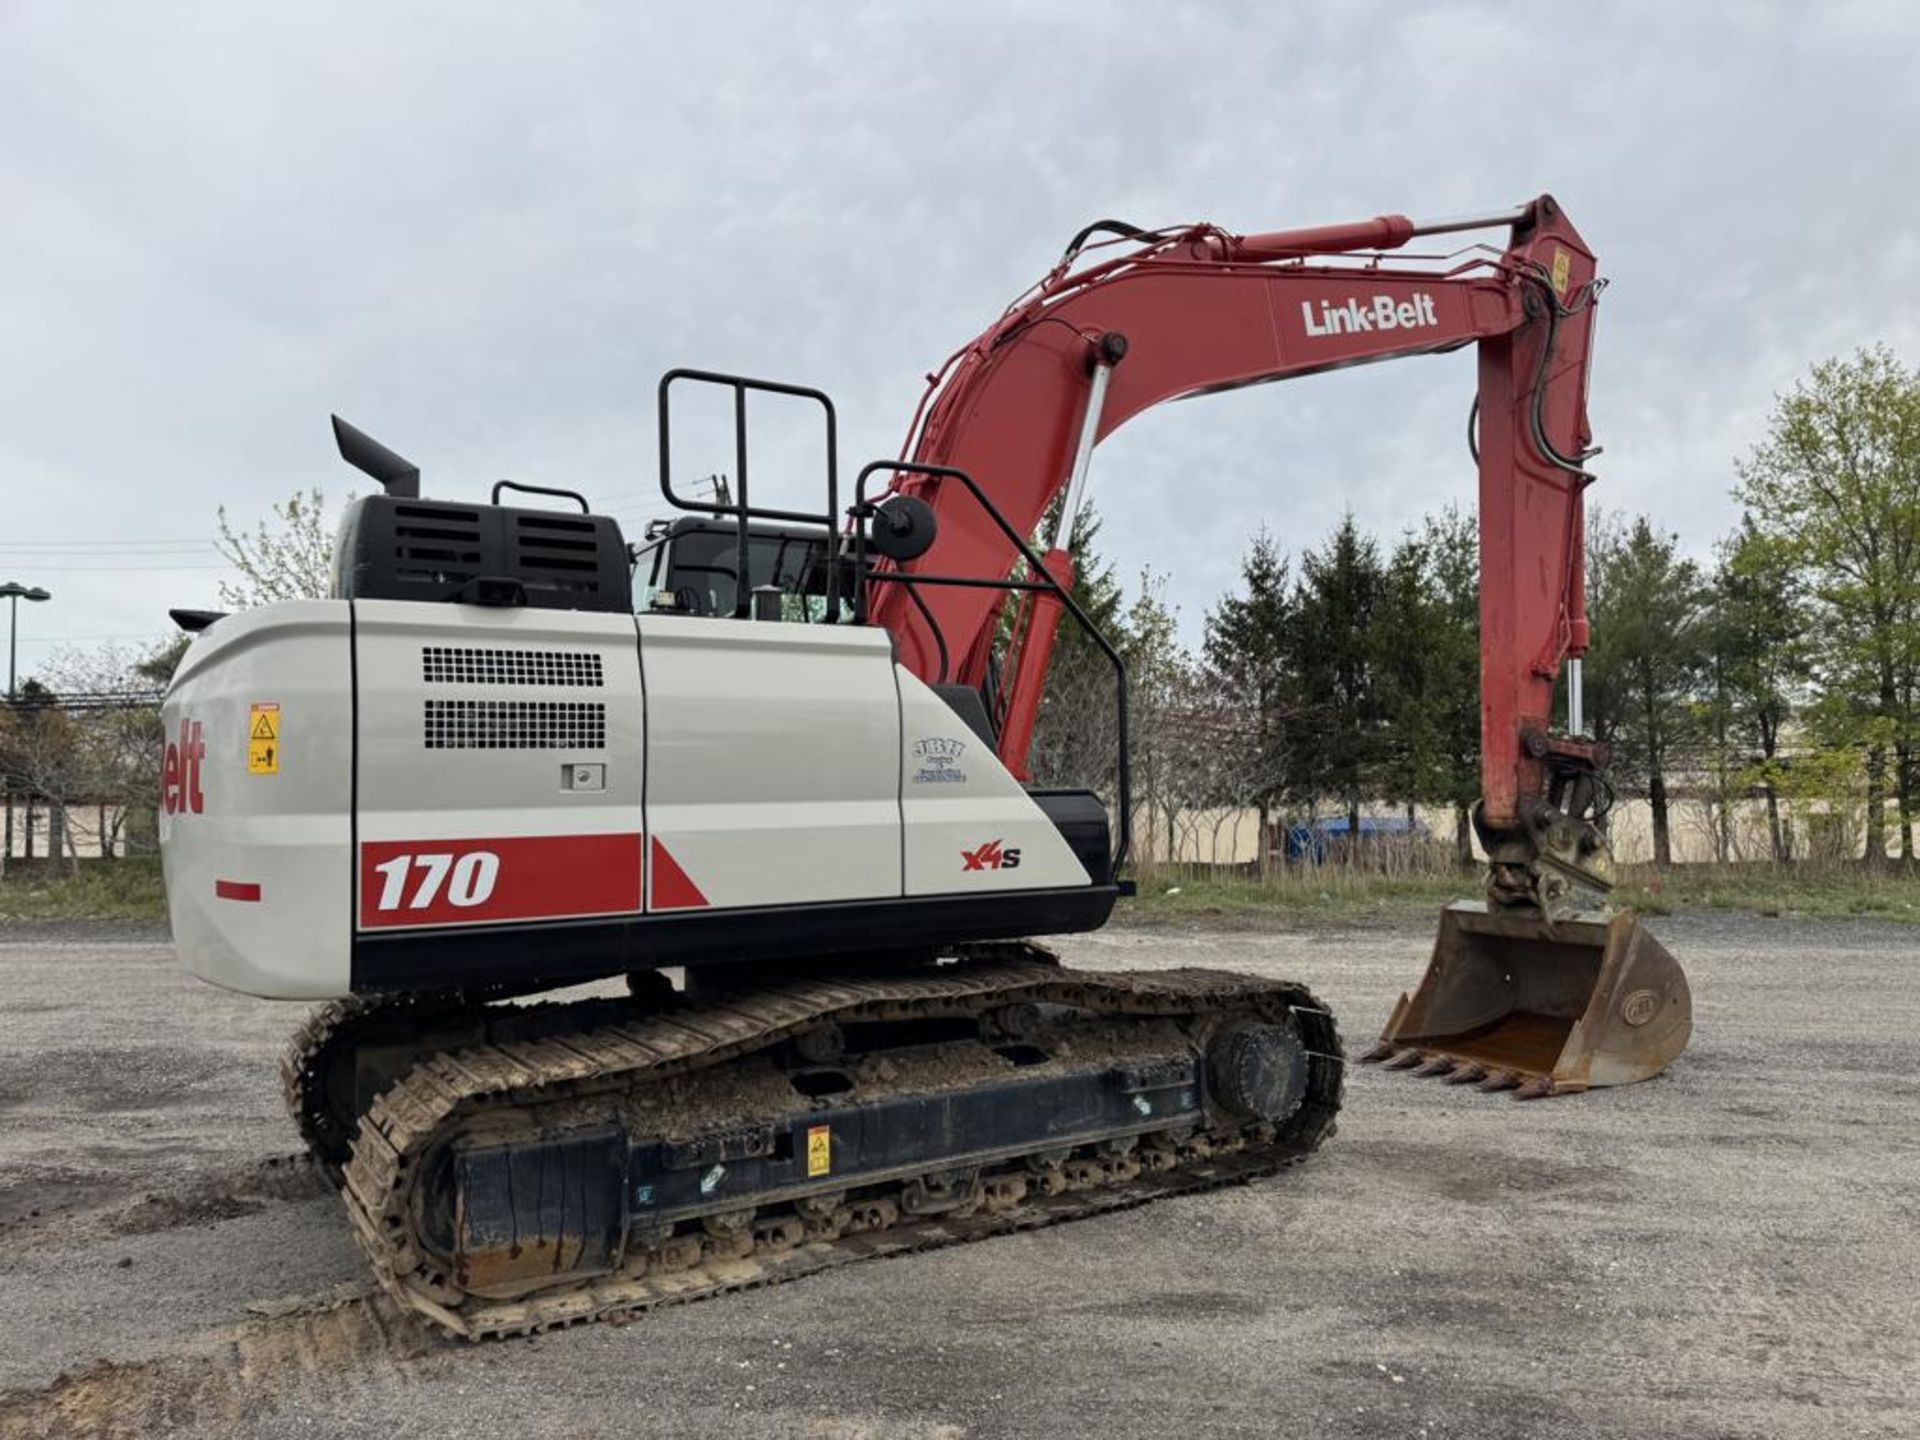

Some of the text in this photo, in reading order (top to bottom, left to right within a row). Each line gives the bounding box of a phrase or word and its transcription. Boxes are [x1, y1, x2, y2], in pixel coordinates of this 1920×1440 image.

[1301, 292, 1438, 337] Link-Belt
[161, 717, 205, 815] elt
[375, 851, 500, 910] 170
